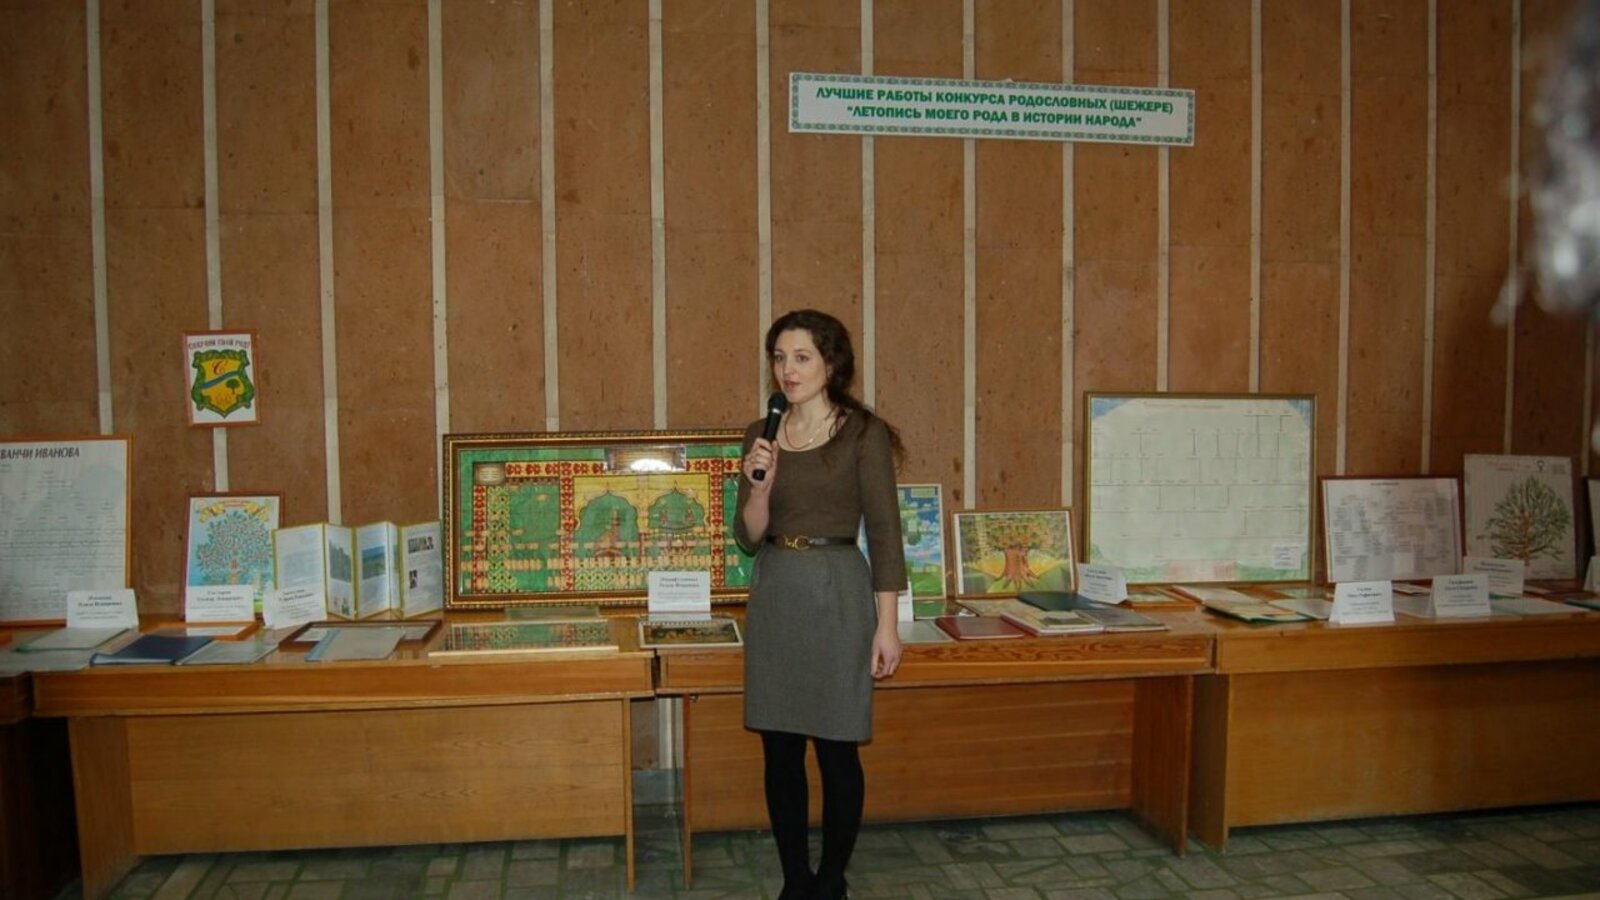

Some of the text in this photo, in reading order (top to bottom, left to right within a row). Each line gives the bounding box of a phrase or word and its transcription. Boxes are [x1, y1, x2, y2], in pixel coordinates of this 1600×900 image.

[816, 87, 1174, 115] ЛУЧШИЕ РАБОТЫ КОНКУРСА РОДОСЛОВНЫХ (ШЕЖЕРЕ)
[847, 106, 1142, 128] "ЛЕТОПИСЬ МОЕГО РОДА В ИСТОРИИ НАРОДА"
[34, 447, 80, 459] ИВАНОВА
